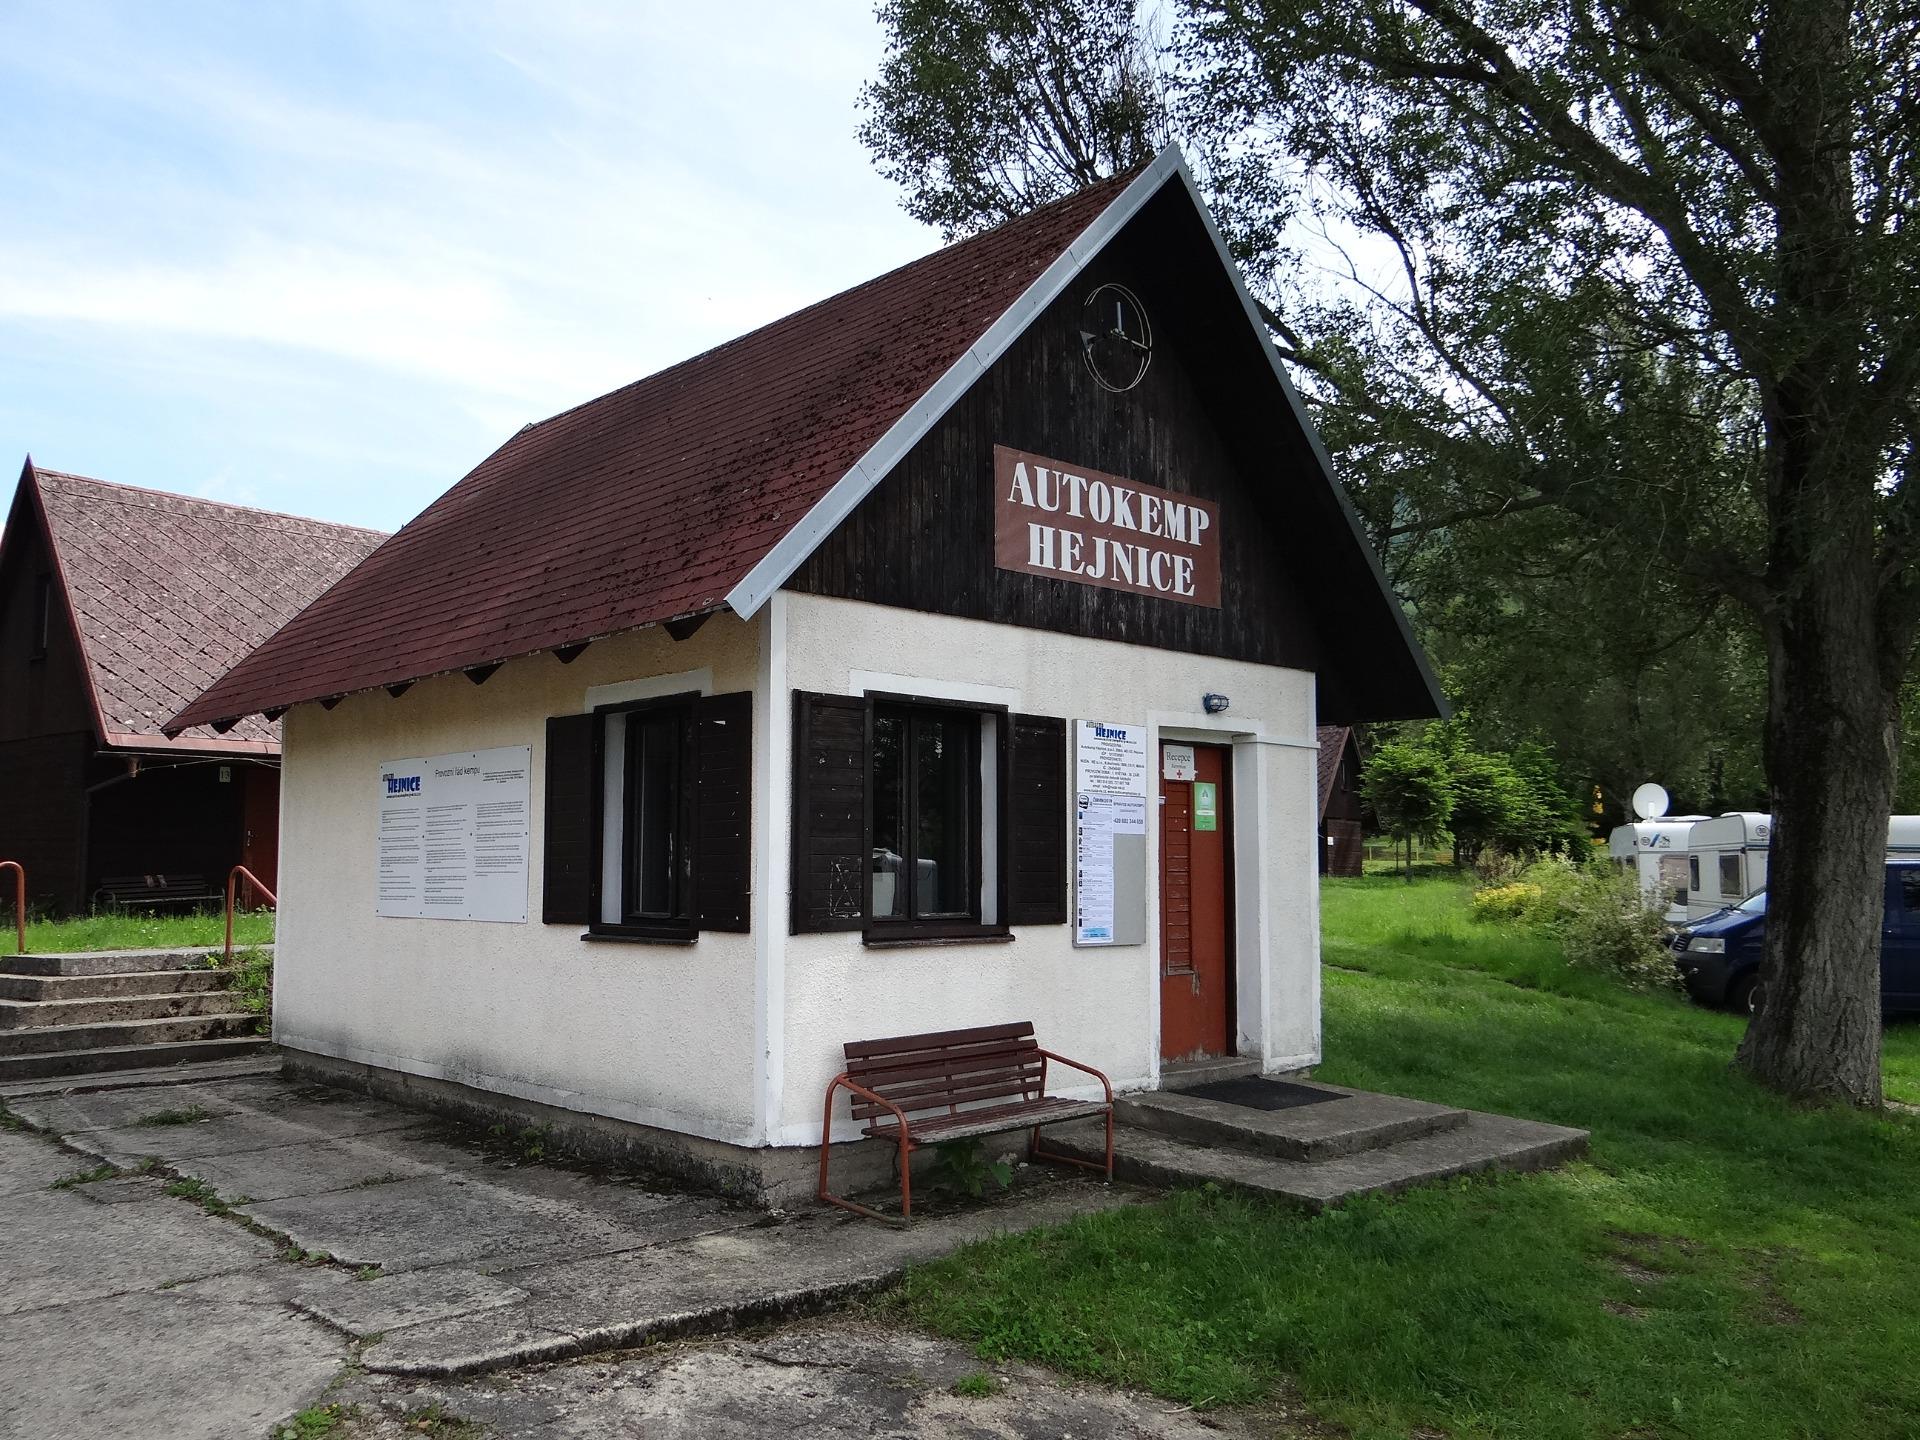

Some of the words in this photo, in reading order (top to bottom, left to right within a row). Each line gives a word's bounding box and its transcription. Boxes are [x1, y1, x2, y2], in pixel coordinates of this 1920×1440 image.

[1007, 461, 1210, 546] AUTOKEMP
[1027, 522, 1195, 597] HEJNICE
[1096, 727, 1126, 740] HEJNICE
[1166, 751, 1191, 764] Recepce
[387, 776, 421, 794] HEJNICE
